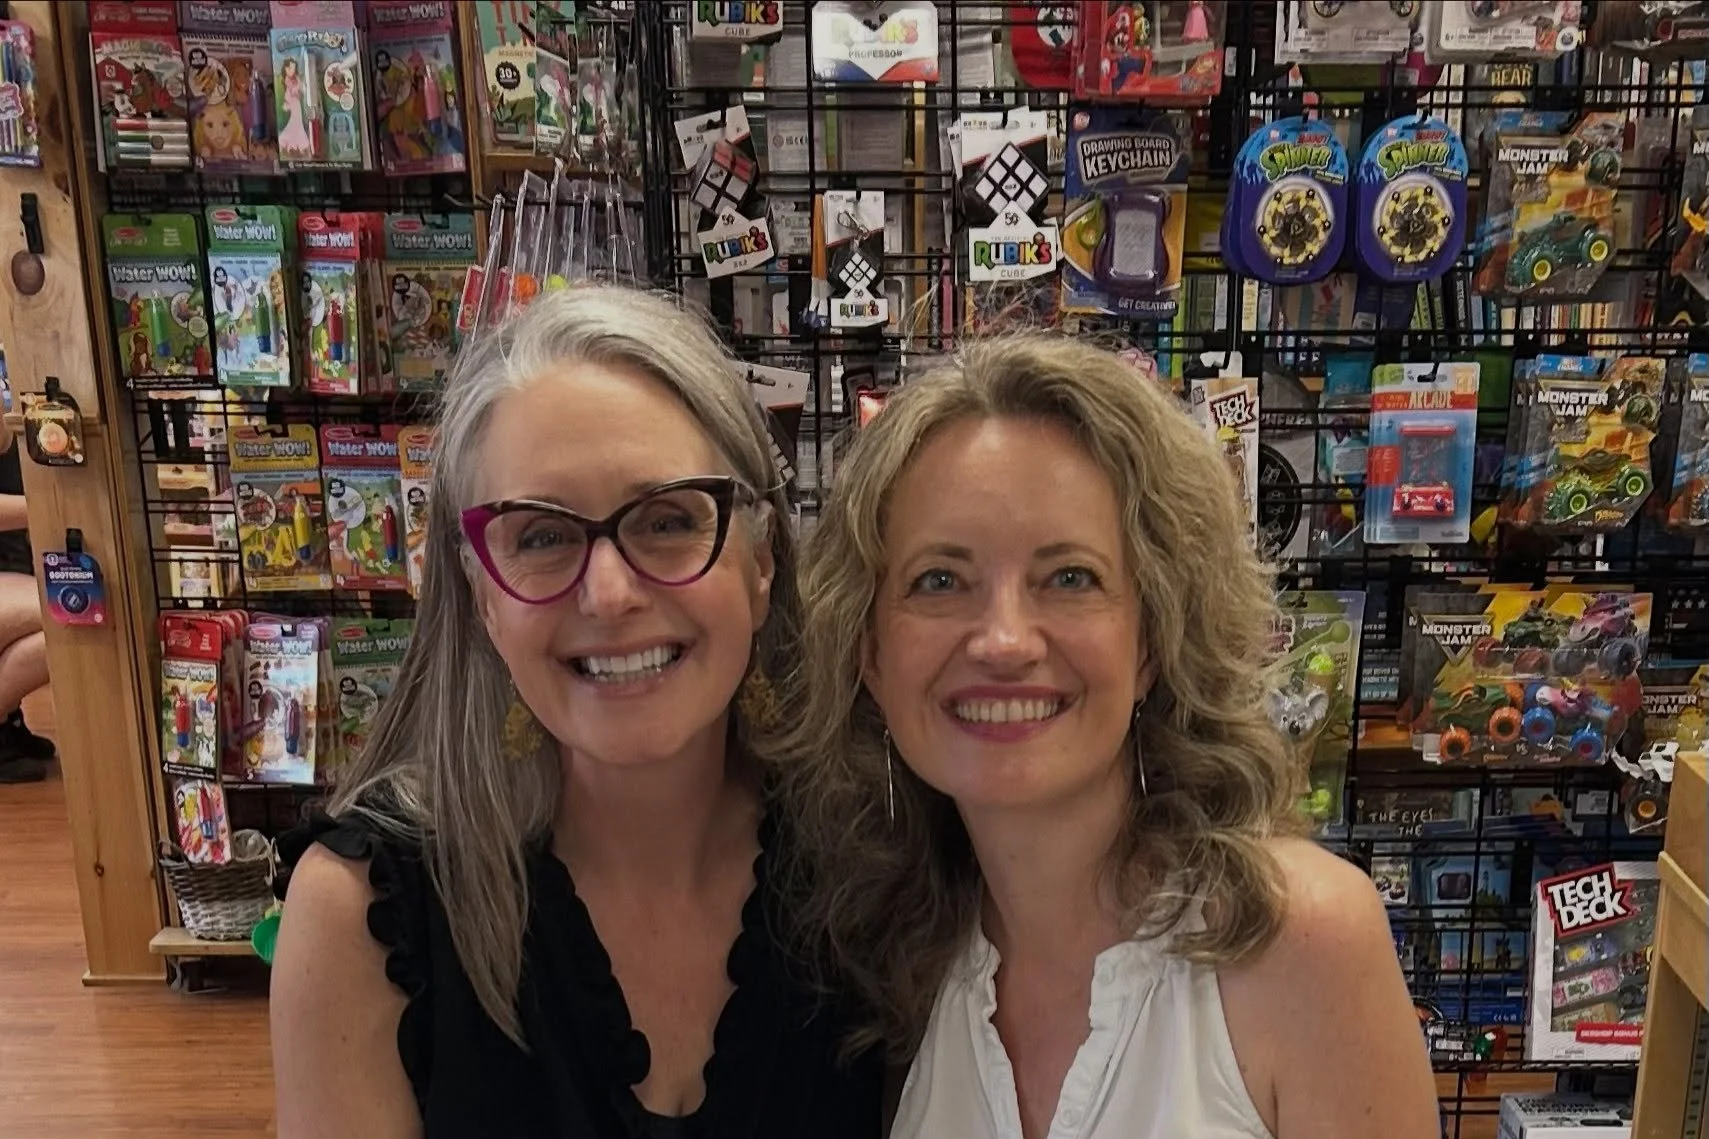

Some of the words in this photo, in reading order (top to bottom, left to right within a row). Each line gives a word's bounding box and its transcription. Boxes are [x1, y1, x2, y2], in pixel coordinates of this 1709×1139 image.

[232, 7, 268, 24] WOW
[725, 27, 751, 36] CUBE
[848, 49, 903, 58] PROFESSOR
[1083, 136, 1132, 156] DRAWING
[1134, 138, 1170, 150] BOARD
[1260, 143, 1332, 183] SPINNER
[1377, 141, 1449, 181] SPINNER
[1498, 149, 1570, 162] MONSTER
[1085, 150, 1171, 179] KEYCHAIN
[1516, 161, 1548, 174] JAM
[213, 225, 243, 240] Water
[244, 223, 276, 241] WOW!
[392, 234, 430, 249] Water
[433, 233, 473, 249] WOW!
[113, 265, 153, 282] Water
[155, 263, 198, 282] WOW!
[1001, 269, 1026, 278] CUBE
[1212, 395, 1245, 417] TECH
[1408, 390, 1453, 409] ARCADE
[1537, 391, 1609, 406] MONSTER
[1219, 406, 1252, 426] DECK
[1556, 404, 1588, 417] JAM
[235, 442, 272, 457] Water
[273, 441, 311, 457] WOW!
[328, 441, 363, 456] Water
[364, 441, 399, 457] WOW
[1422, 624, 1492, 636] MONSTER
[1441, 635, 1473, 645] JAM
[1648, 704, 1679, 714] JAM
[1369, 809, 1399, 823] THE
[1402, 808, 1434, 823] EYES
[1399, 825, 1424, 837] THE
[1548, 872, 1613, 910] TECH
[1559, 891, 1627, 930] DECK
